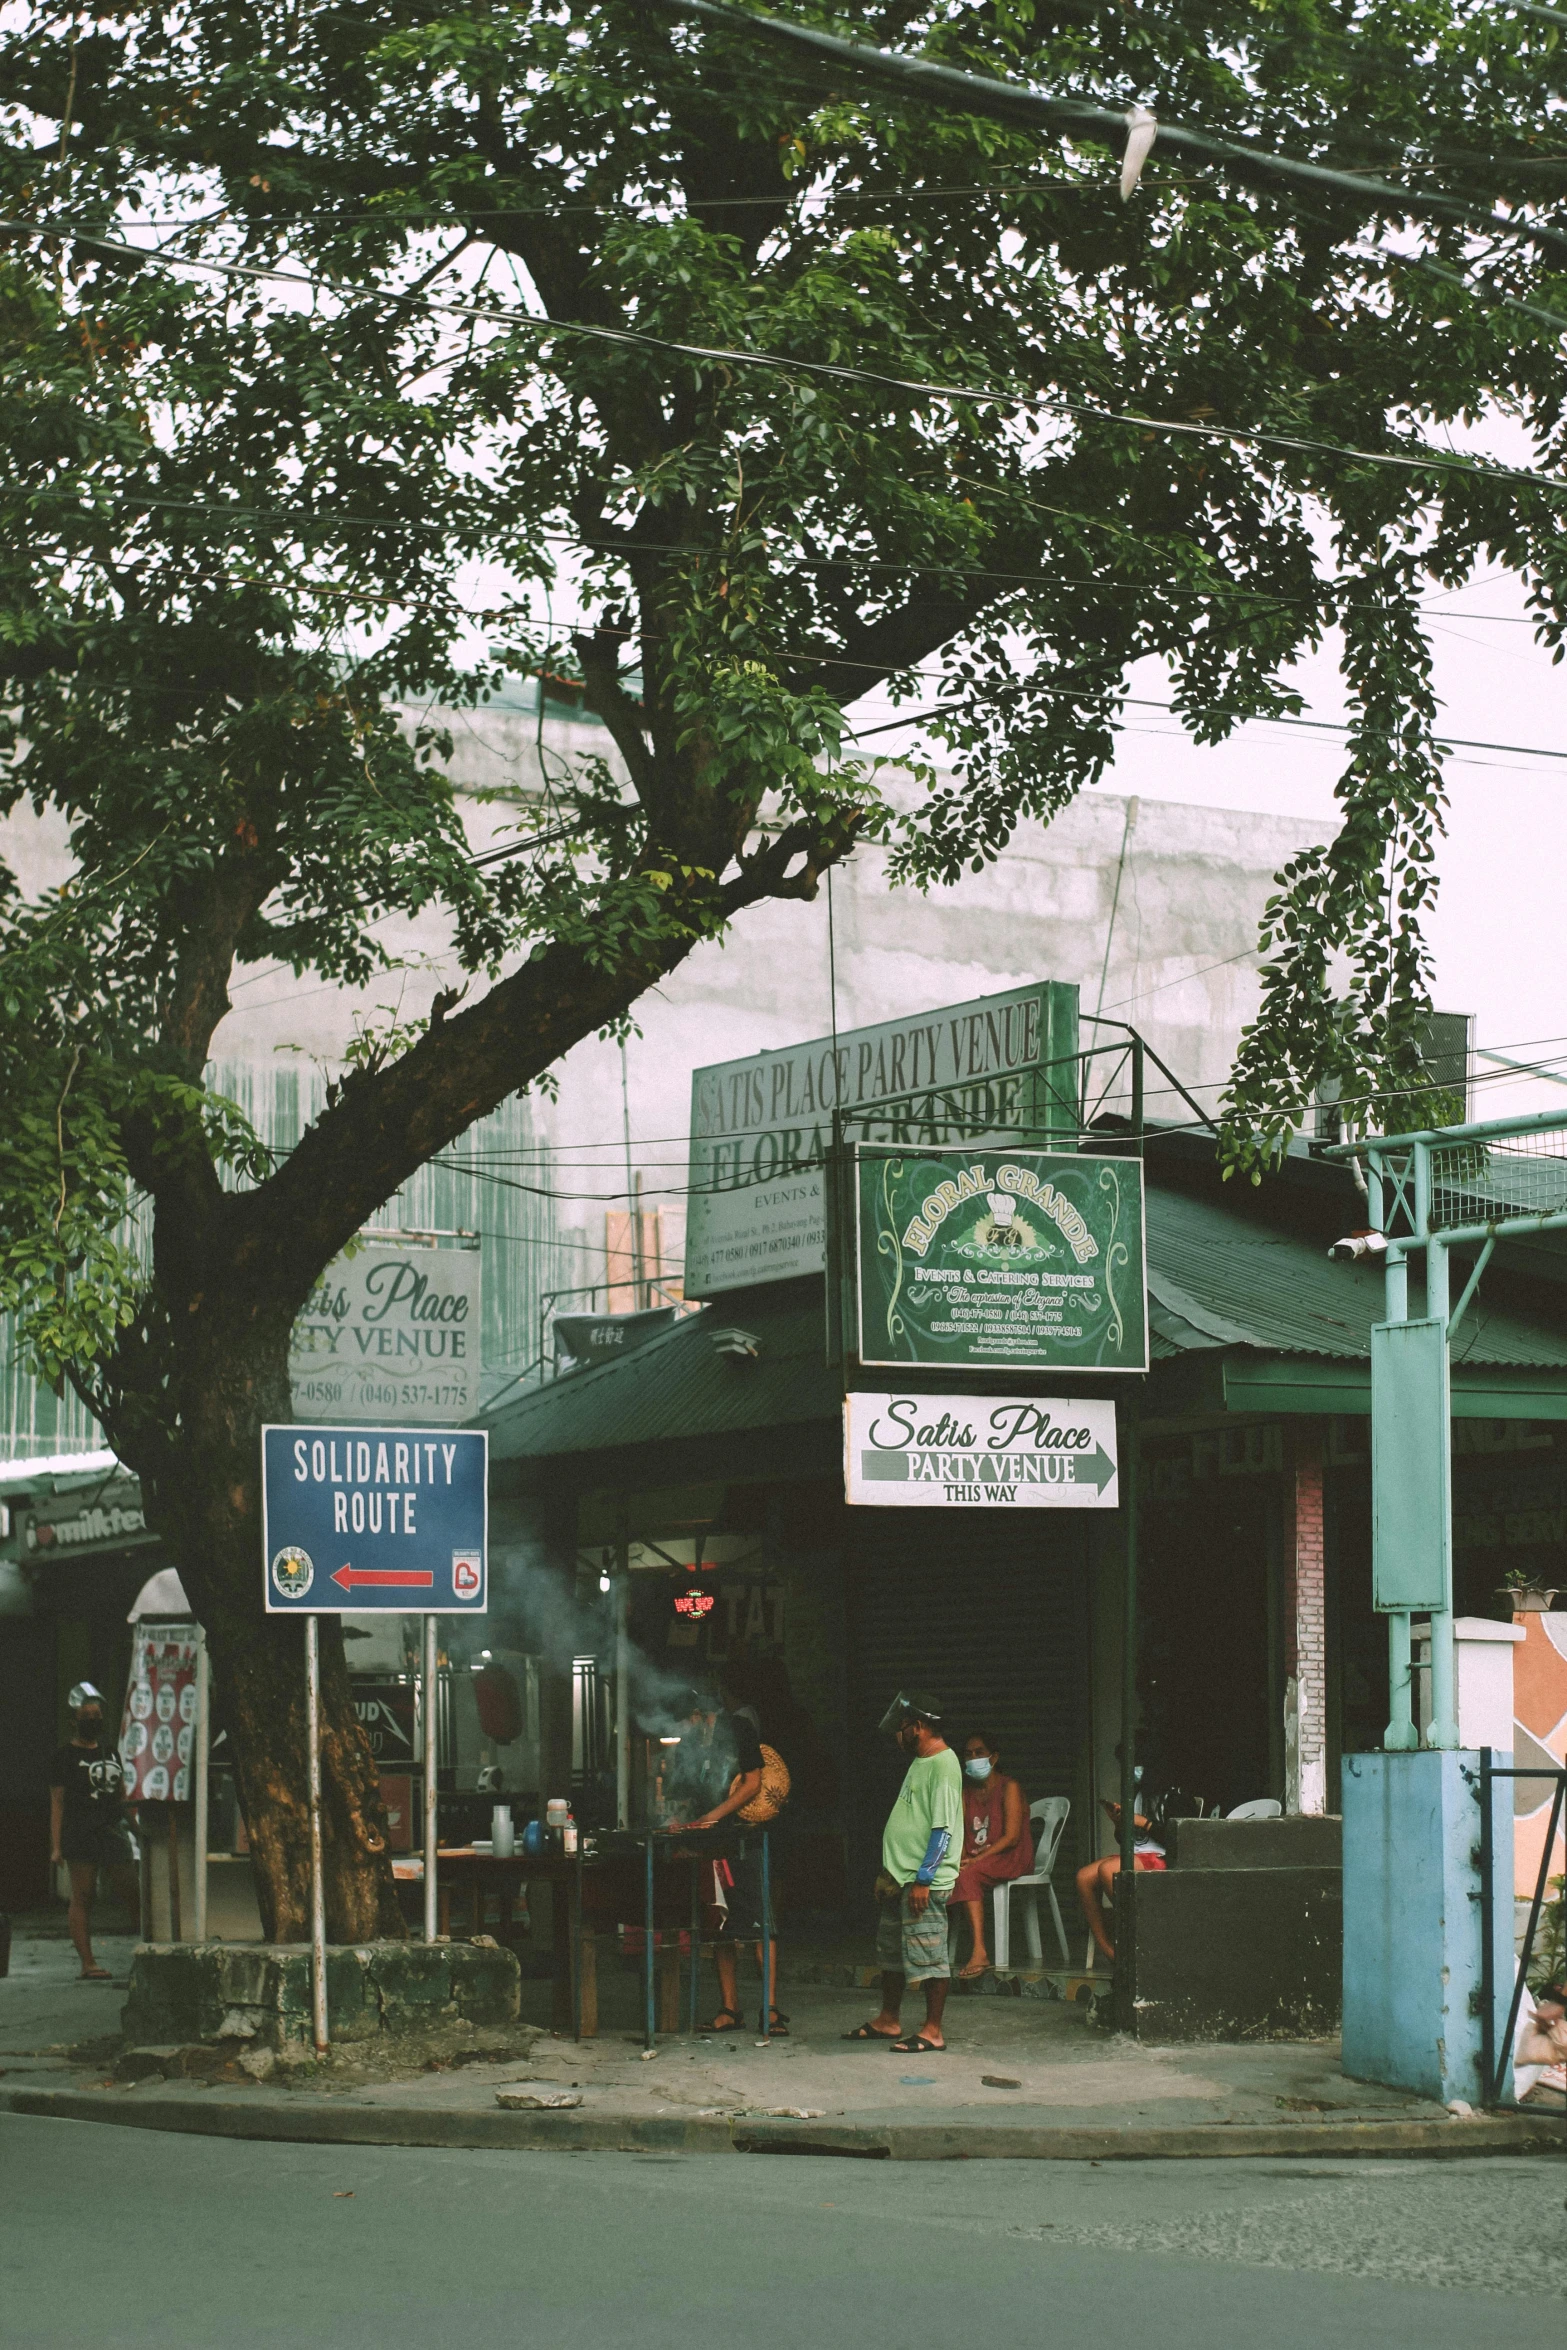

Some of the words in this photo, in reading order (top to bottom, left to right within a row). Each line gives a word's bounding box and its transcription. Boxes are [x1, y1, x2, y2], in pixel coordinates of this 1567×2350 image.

[698, 1066, 764, 1137] SATIS
[770, 1047, 852, 1122] PLACE
[858, 1022, 944, 1101] PARTY
[950, 998, 1041, 1079] VENUE
[710, 1121, 825, 1192] FLORA
[861, 1075, 1024, 1147] GRANDE
[754, 1187, 806, 1209] EVENTS
[809, 1183, 820, 1197] &
[902, 1165, 995, 1257] FLORAL
[996, 1164, 1099, 1264] GRANDE
[749, 1240, 767, 1258] 0917
[362, 1260, 469, 1323] Place
[915, 1266, 961, 1284] EVENTS
[963, 1269, 976, 1284] &
[976, 1270, 1040, 1287] CATERING
[1041, 1273, 1095, 1288] SERVICES
[971, 1290, 1011, 1308] expression
[1011, 1290, 1024, 1311] of
[352, 1325, 466, 1359] VENUE
[359, 1383, 398, 1409] (046)
[401, 1384, 468, 1406] 537-1775
[869, 1399, 977, 1451] Satis
[987, 1403, 1092, 1450] Place
[294, 1439, 457, 1485] SOLIDARITY
[906, 1452, 984, 1482] PARTY
[987, 1454, 1076, 1483] VENUE
[943, 1484, 981, 1502] THIS
[983, 1485, 1018, 1502] WAY
[334, 1491, 417, 1534] ROUTE
